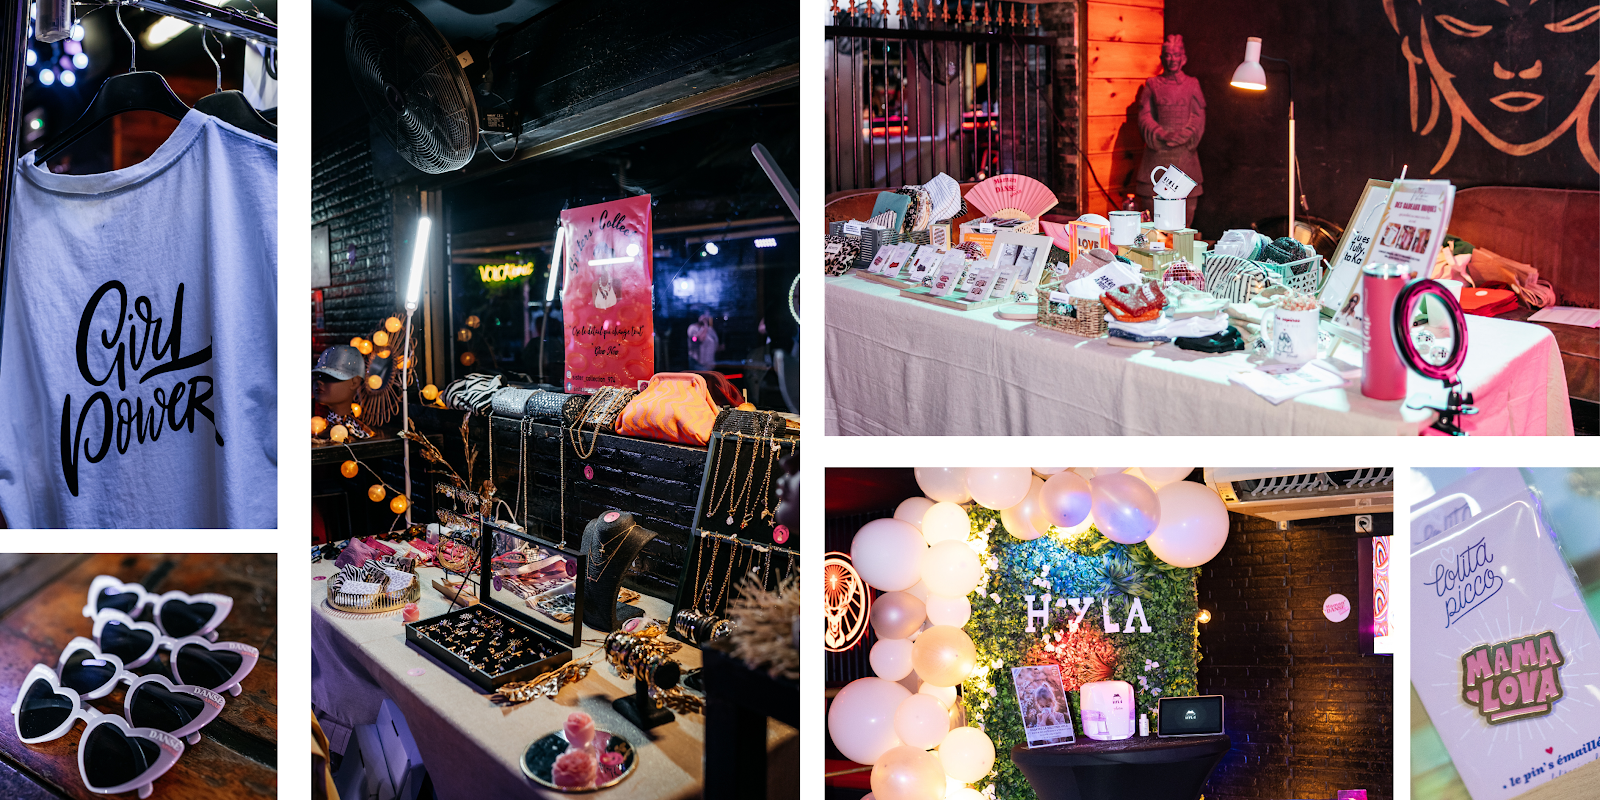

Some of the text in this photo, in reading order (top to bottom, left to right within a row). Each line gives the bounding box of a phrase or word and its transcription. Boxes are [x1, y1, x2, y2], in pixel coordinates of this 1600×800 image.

[1077, 237, 1099, 250] LOVE
[1423, 536, 1494, 598] lolita
[1024, 594, 1152, 634] HYLA
[1445, 568, 1504, 629] picco
[1466, 636, 1561, 687] MAMA
[193, 687, 223, 705] DANSE
[1482, 667, 1560, 713] LOVA
[149, 730, 180, 751] DANSE
[1509, 777, 1521, 787] le
[1523, 762, 1555, 785] pin's
